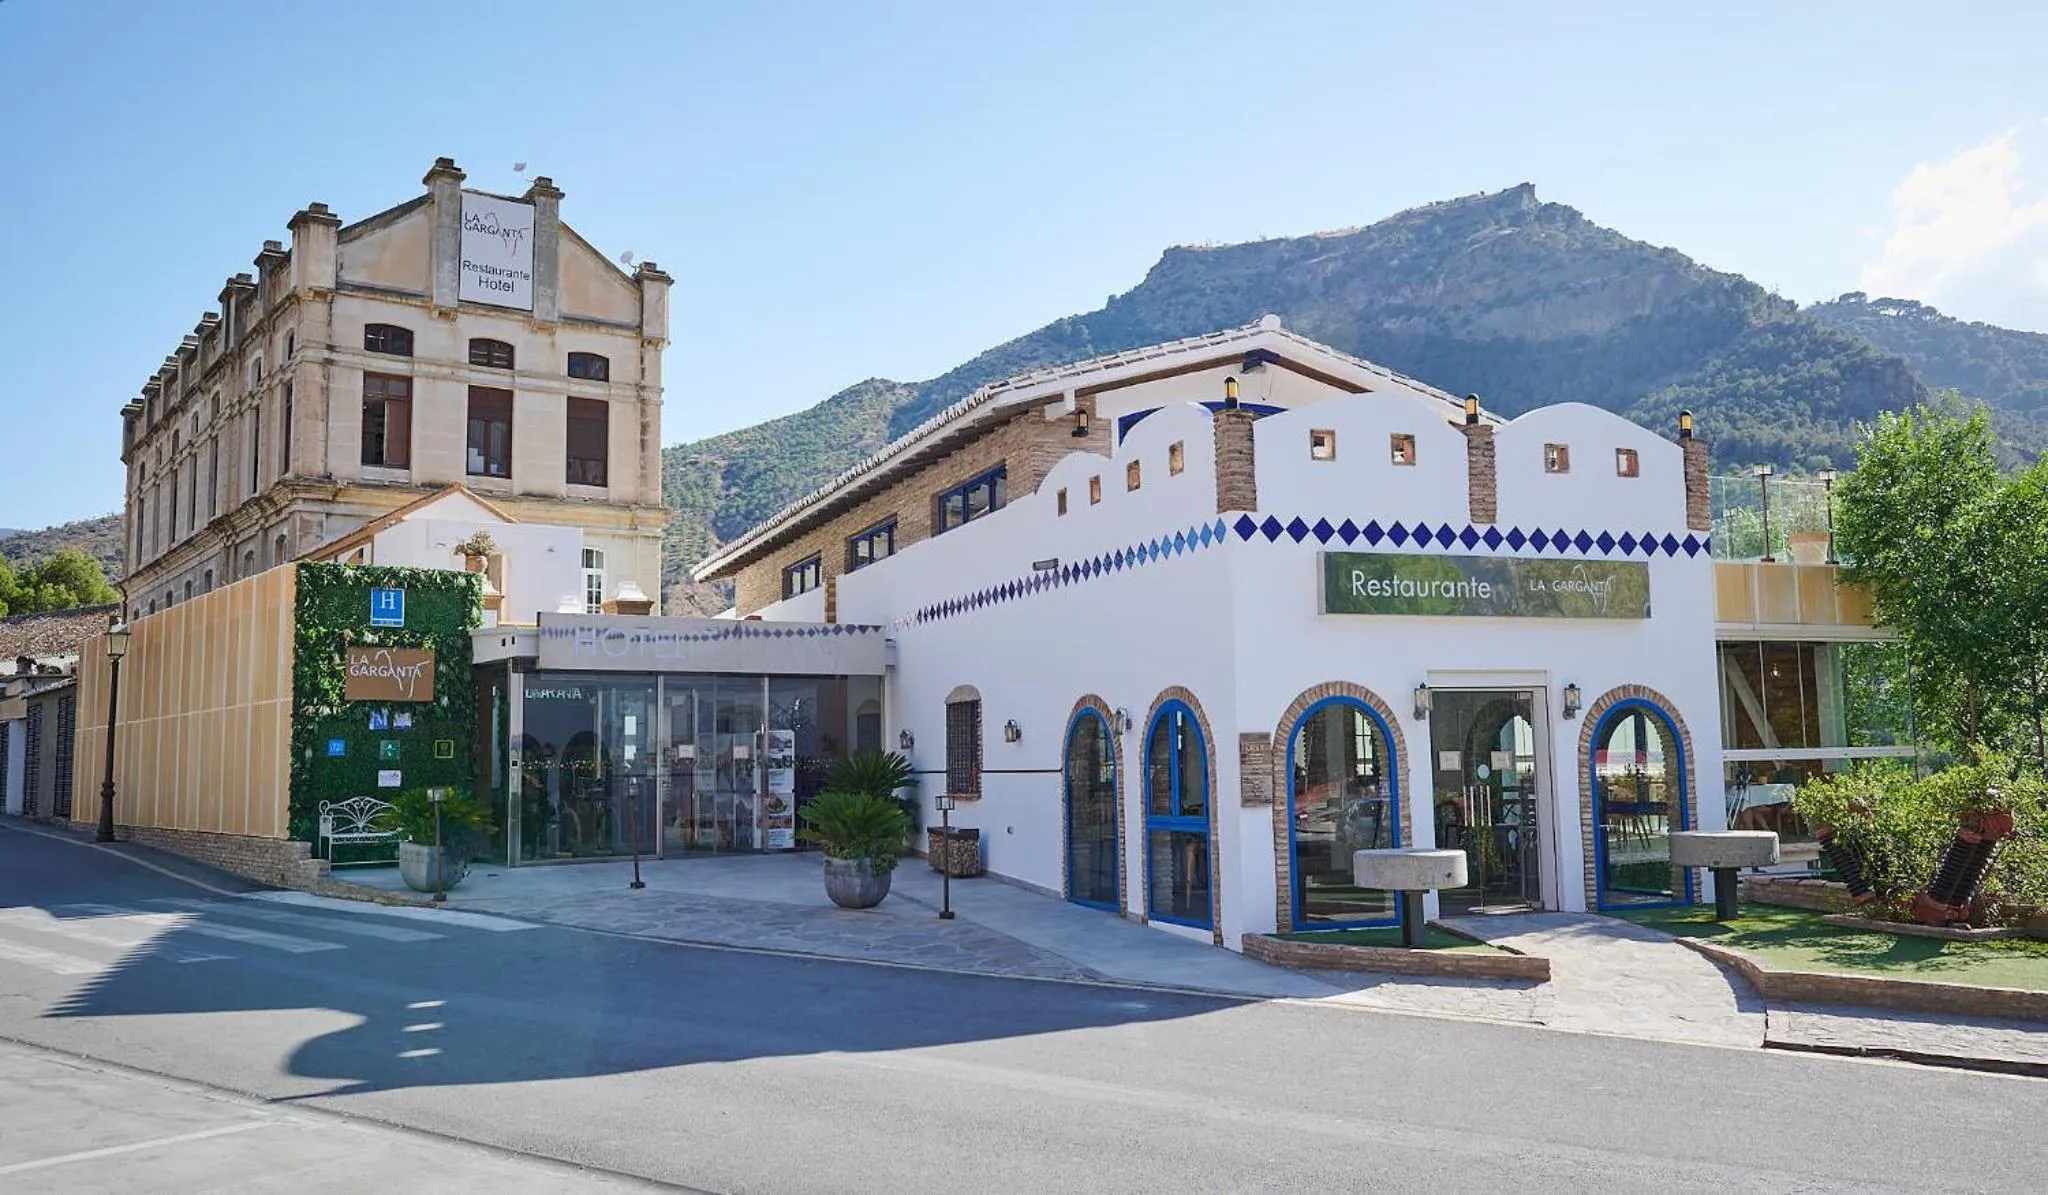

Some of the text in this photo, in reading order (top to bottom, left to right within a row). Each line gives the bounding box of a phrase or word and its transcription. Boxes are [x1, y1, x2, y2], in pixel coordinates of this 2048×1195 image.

[464, 212, 480, 223] LA
[464, 222, 524, 240] GARGANTA
[462, 260, 530, 280] Restaurante
[478, 275, 514, 293] Hotel
[1352, 570, 1612, 599] Restaurante LA GARGANTA
[381, 591, 396, 610] H
[350, 655, 369, 665] LA
[350, 664, 422, 678] GARGANTA
